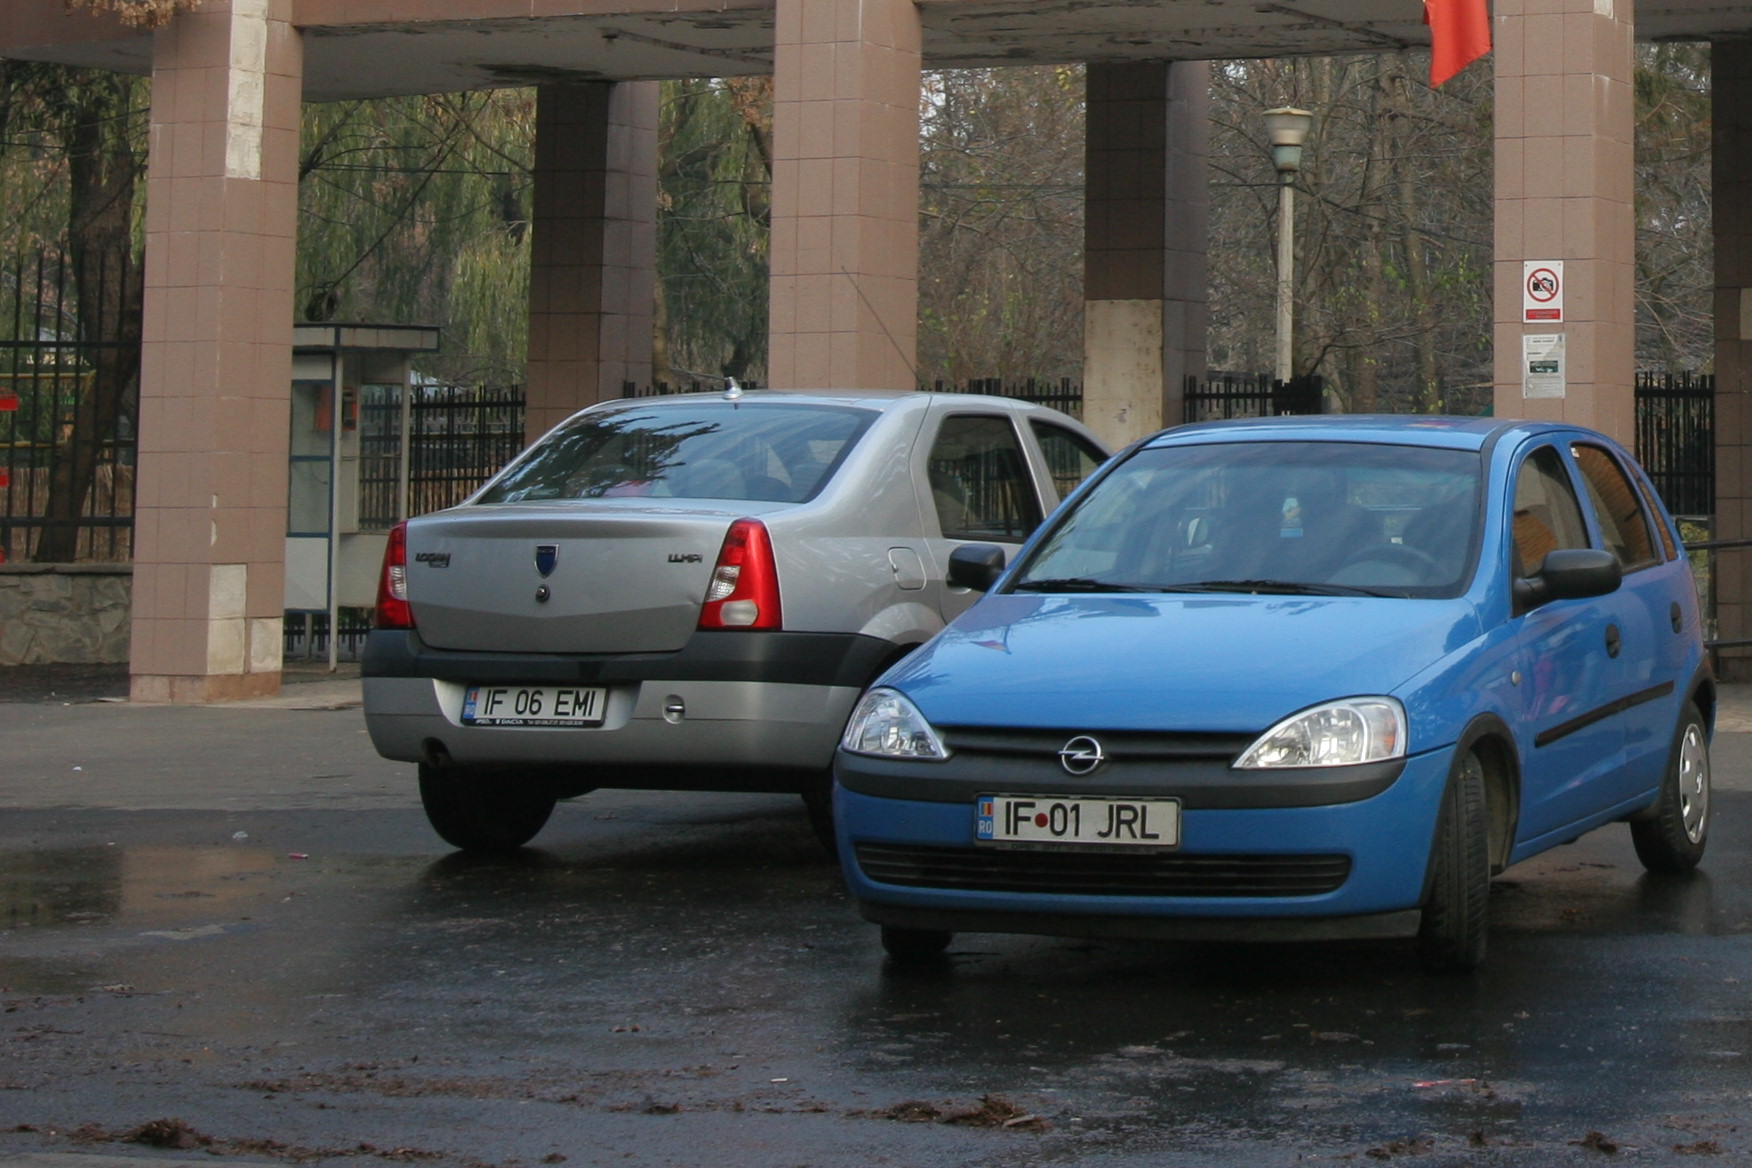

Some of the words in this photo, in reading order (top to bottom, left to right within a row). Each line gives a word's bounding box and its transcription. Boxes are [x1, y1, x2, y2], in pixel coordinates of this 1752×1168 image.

[484, 689, 508, 715] IF
[514, 689, 544, 715] 06
[554, 690, 597, 716] EMI
[979, 820, 993, 833] RO
[1005, 801, 1036, 836] IF
[1049, 802, 1080, 837] 01
[1097, 804, 1159, 839] JRL
